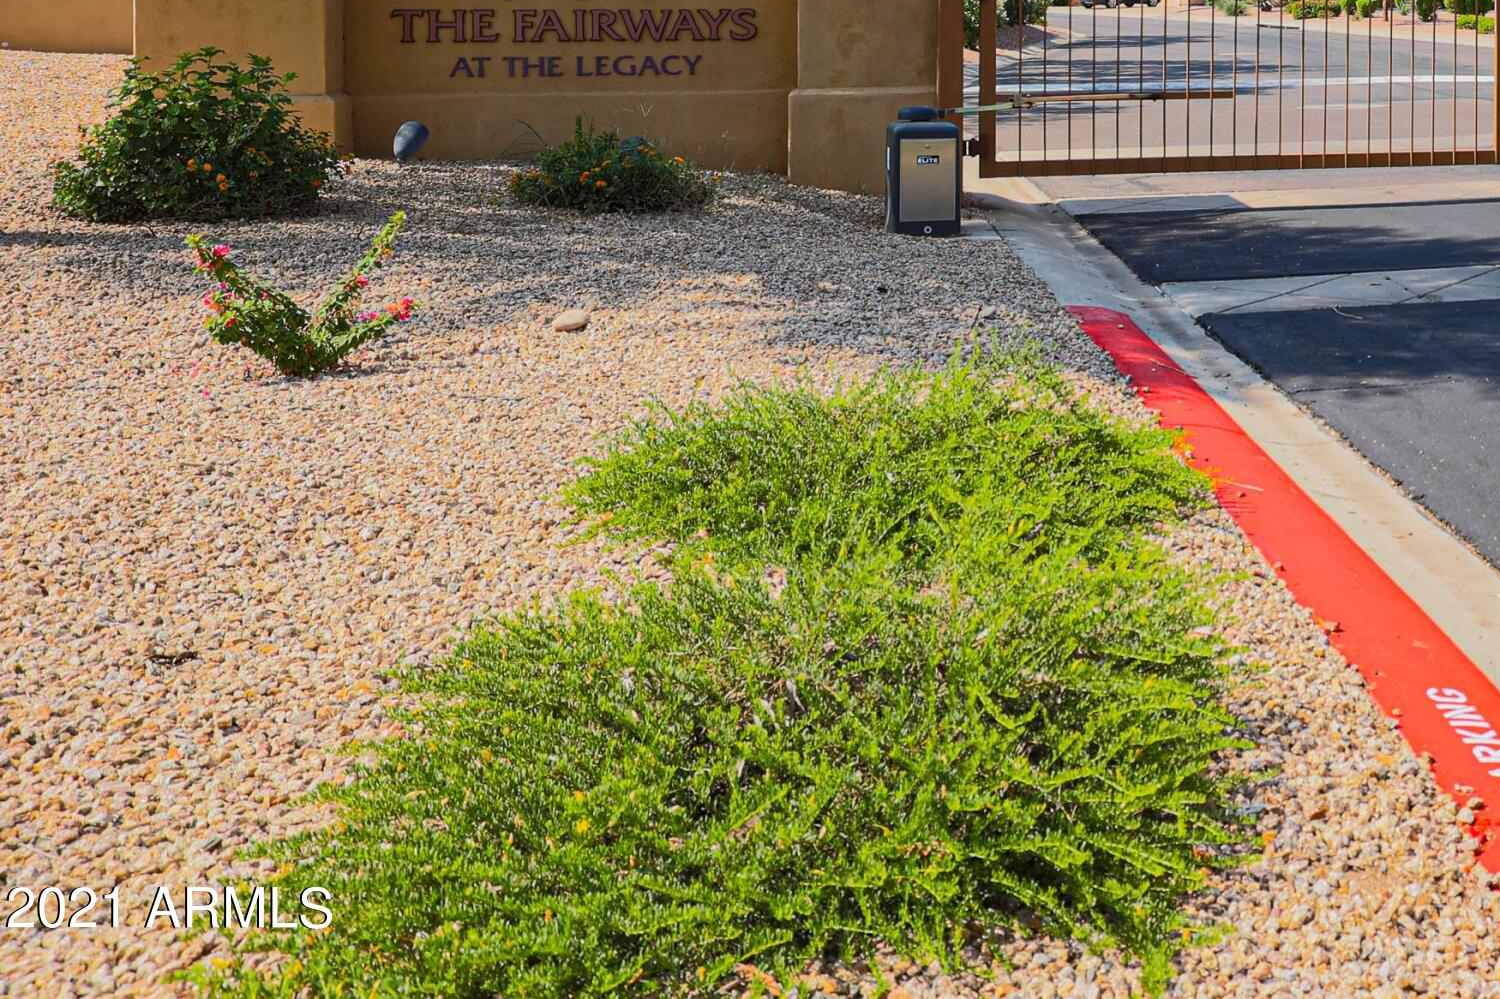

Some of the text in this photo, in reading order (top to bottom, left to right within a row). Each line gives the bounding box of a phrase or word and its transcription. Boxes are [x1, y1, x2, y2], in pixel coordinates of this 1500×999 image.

[390, 8, 759, 43] THE FAIRWAYS
[449, 55, 703, 78] AT THE LEGACY
